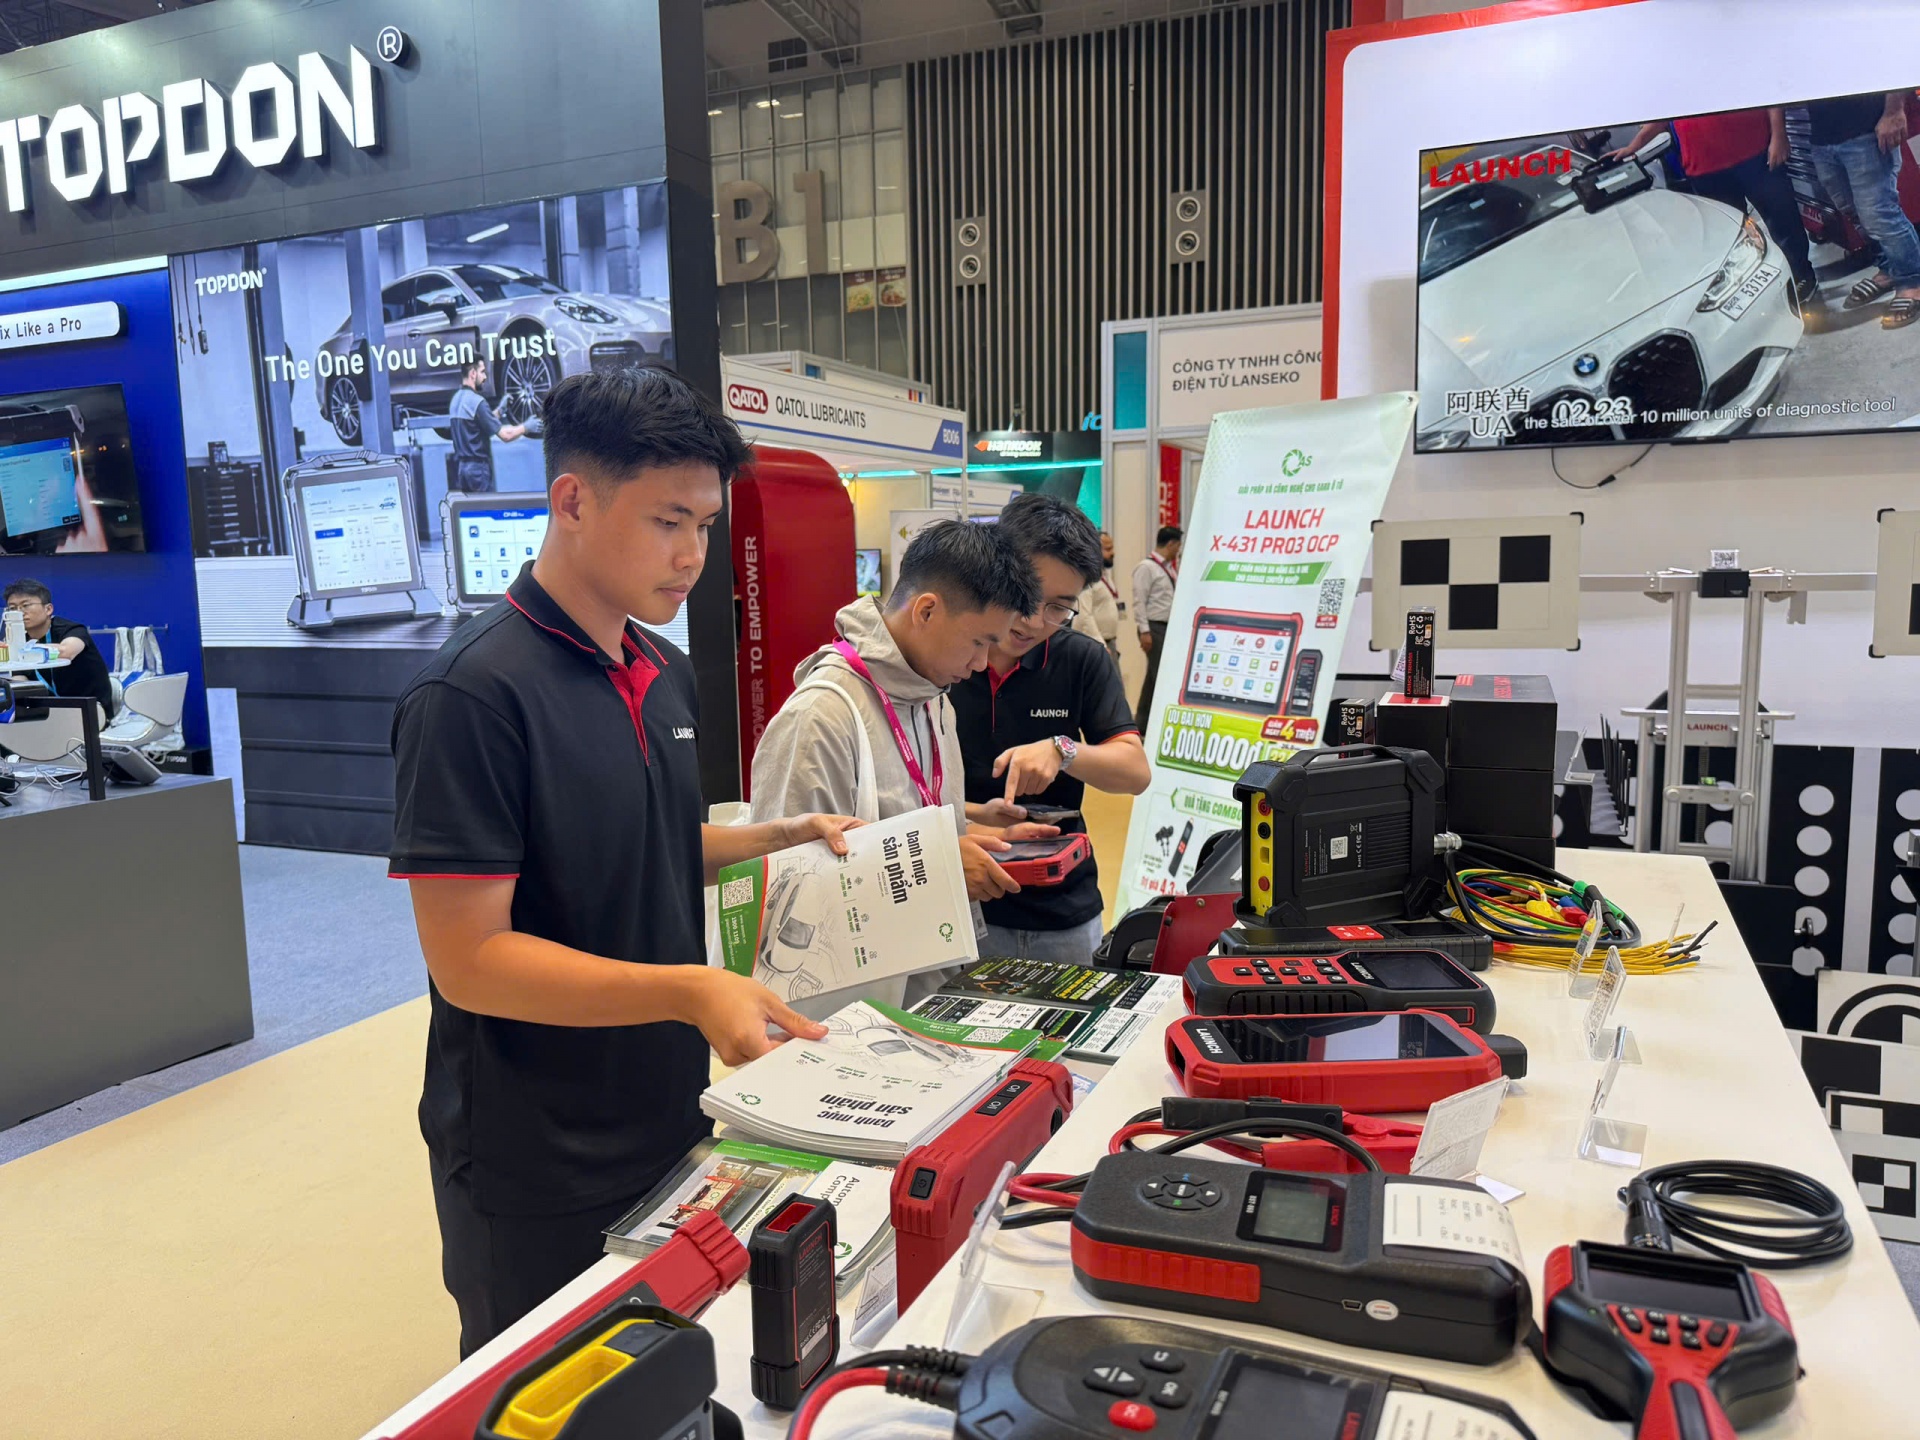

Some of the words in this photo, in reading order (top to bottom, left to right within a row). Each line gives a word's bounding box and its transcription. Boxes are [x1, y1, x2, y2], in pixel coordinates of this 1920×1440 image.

[0, 44, 380, 212] TOPDON
[1430, 149, 1572, 188] LAUNCH
[718, 170, 828, 285] B1
[195, 268, 264, 296] TOPDON
[1741, 270, 1773, 298] 53754
[16, 322, 41, 338] Like
[47, 323, 55, 334] a
[60, 317, 82, 332] Pro
[265, 355, 310, 382] The
[317, 350, 364, 378] One
[371, 344, 417, 372] You
[425, 339, 474, 367] Can
[483, 329, 557, 361] Trust
[1173, 357, 1214, 375] CÔNG
[1217, 356, 1236, 371] TY
[1239, 353, 1280, 369] TNHH
[1172, 375, 1206, 393] ĐIỆN
[1232, 371, 1300, 387] LANSEKO
[730, 385, 768, 411] QATOL
[1446, 387, 1531, 415] 阿联酋
[776, 395, 809, 419] QATOL
[811, 404, 866, 429] LUBRICANTS
[1524, 416, 1549, 430] the
[1551, 413, 1580, 428] sale
[1641, 410, 1657, 423] 10
[1661, 408, 1710, 423] million
[1714, 405, 1752, 420] units
[1757, 404, 1773, 418] of
[1775, 400, 1860, 419] diagnostic
[1864, 397, 1896, 412] tool
[1470, 414, 1515, 438] UA
[1244, 508, 1325, 530] LAUNCH
[1210, 535, 1258, 553] X-431
[745, 536, 762, 640] EMPOWER
[1408, 615, 1416, 635] RoHS
[751, 647, 762, 673] TO
[1030, 709, 1069, 718] LAUNCH
[1280, 719, 1295, 740] 4
[1687, 723, 1728, 732] LAUNCH
[882, 835, 903, 861] sản
[905, 829, 923, 858] Danh
[884, 860, 913, 904] phẩm
[911, 859, 928, 887] mục
[1350, 961, 1375, 980] LAUNCH
[1195, 1027, 1224, 1055] LAUNCH
[820, 1093, 866, 1110] phẩm
[867, 1102, 913, 1117] sản
[817, 1110, 854, 1124] mục
[856, 1115, 896, 1128] Danh
